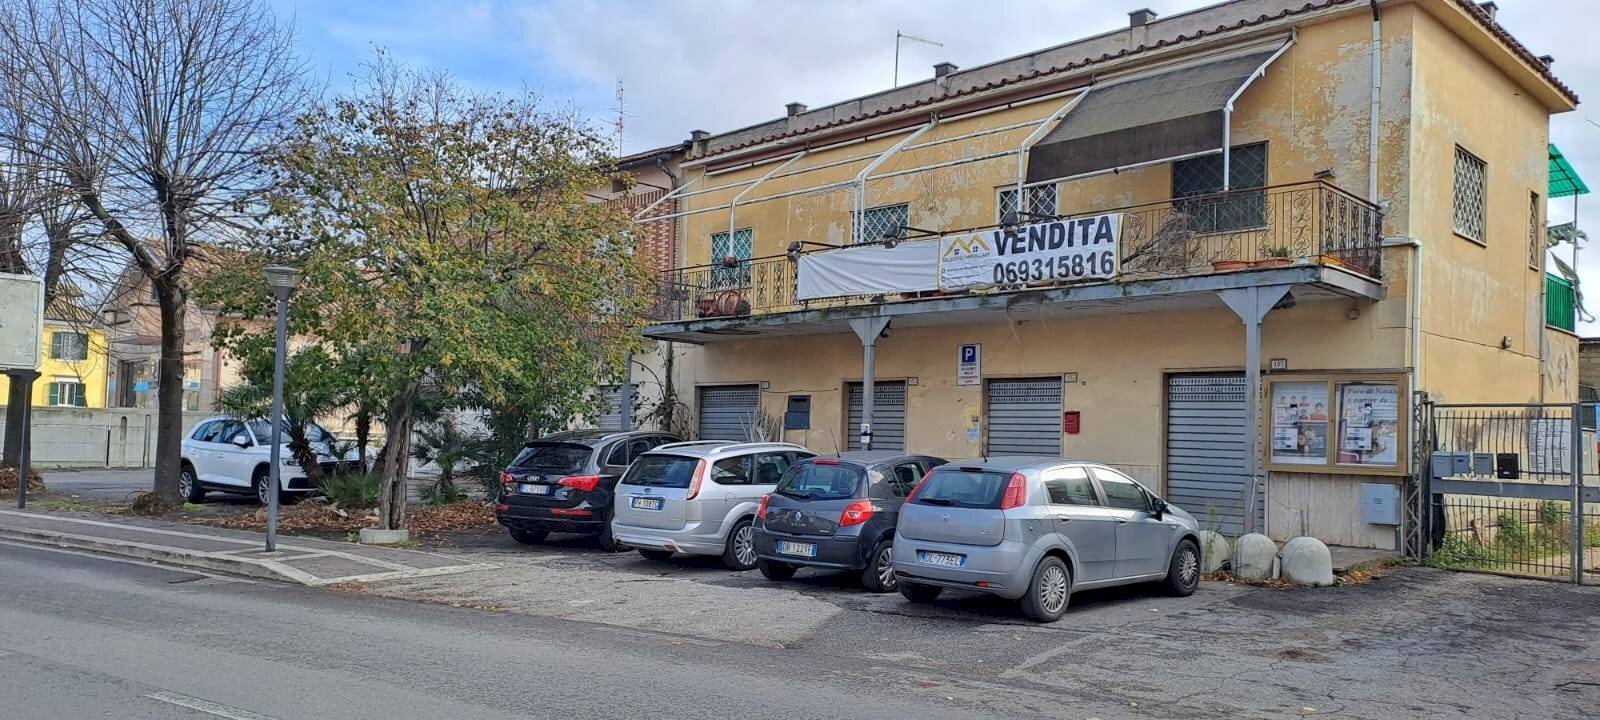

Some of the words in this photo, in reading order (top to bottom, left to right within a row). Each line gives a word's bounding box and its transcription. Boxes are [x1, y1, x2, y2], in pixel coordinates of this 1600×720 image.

[994, 216, 1113, 256] VENDITA
[993, 251, 1114, 283] 069315816
[965, 348, 973, 361] P
